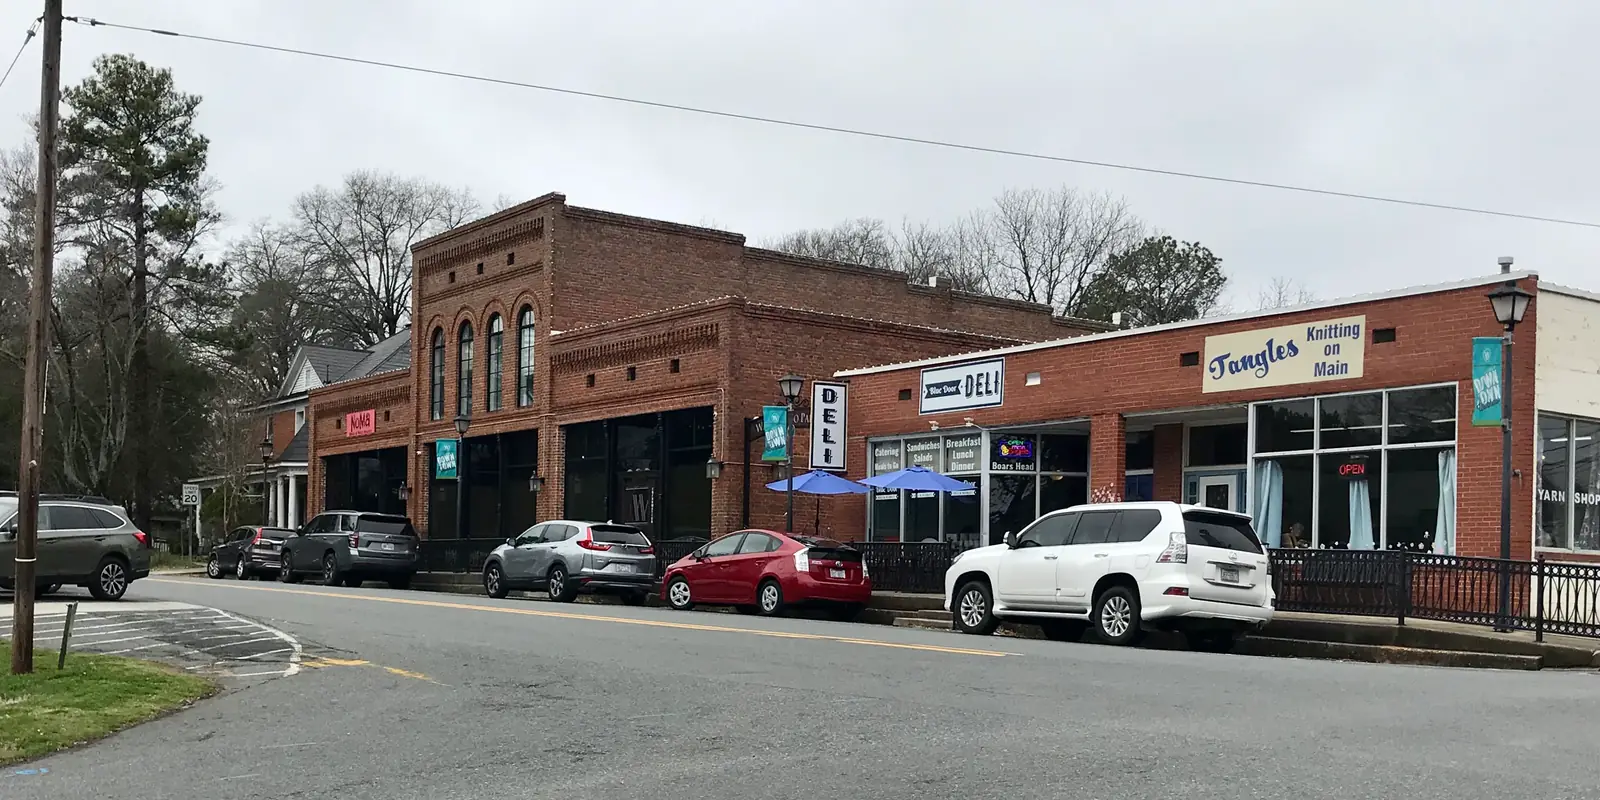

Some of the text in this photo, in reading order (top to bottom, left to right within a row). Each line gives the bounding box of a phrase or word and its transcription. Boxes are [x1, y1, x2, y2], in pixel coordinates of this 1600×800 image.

[1306, 323, 1360, 341] Knitting
[1324, 343, 1340, 356] on
[1208, 338, 1299, 380] Tangles
[1314, 360, 1348, 377] Main
[929, 370, 1000, 399] Blue Door DELI
[821, 388, 838, 464] DELI
[906, 441, 940, 452] Sandwiches
[946, 437, 981, 448] Breakfast
[875, 447, 899, 457] Catering
[952, 449, 974, 459] Lunch
[913, 453, 933, 463] Salads
[951, 462, 975, 471] Dinner
[992, 461, 1035, 471] Boars Head
[1339, 463, 1365, 475] OPEN
[185, 494, 197, 503] 20
[1538, 489, 1600, 505] YARN SHOP
